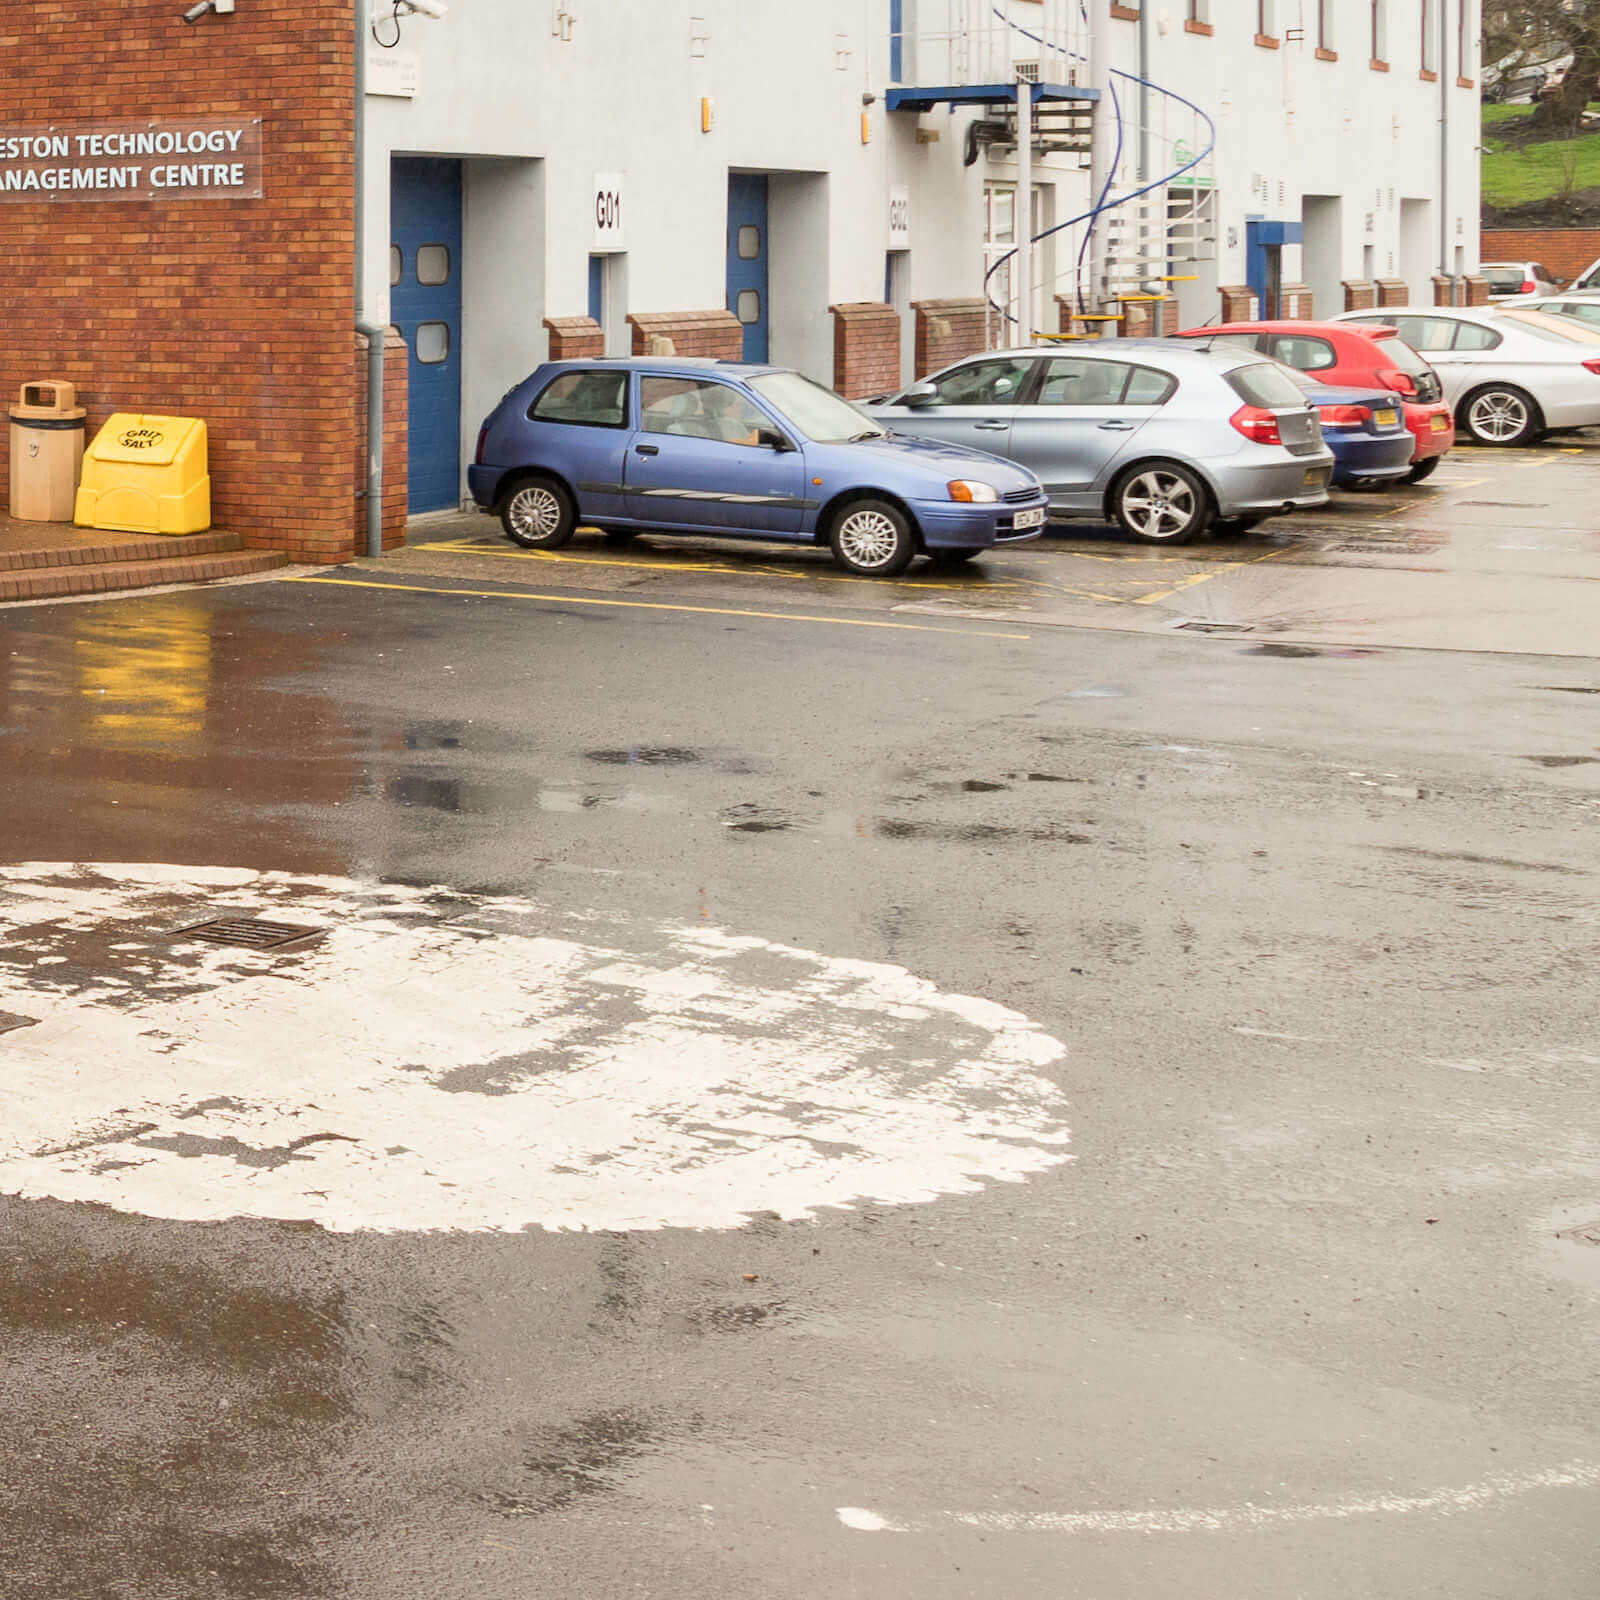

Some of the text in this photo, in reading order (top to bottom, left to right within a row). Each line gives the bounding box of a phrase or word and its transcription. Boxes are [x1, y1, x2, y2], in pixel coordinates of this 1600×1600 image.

[75, 130, 242, 157] TECHNOLOGY
[150, 164, 244, 188] CENTRE
[596, 190, 620, 230] G01
[890, 199, 908, 231] G02
[121, 438, 152, 449] SALT
[126, 429, 162, 438] GRIT
